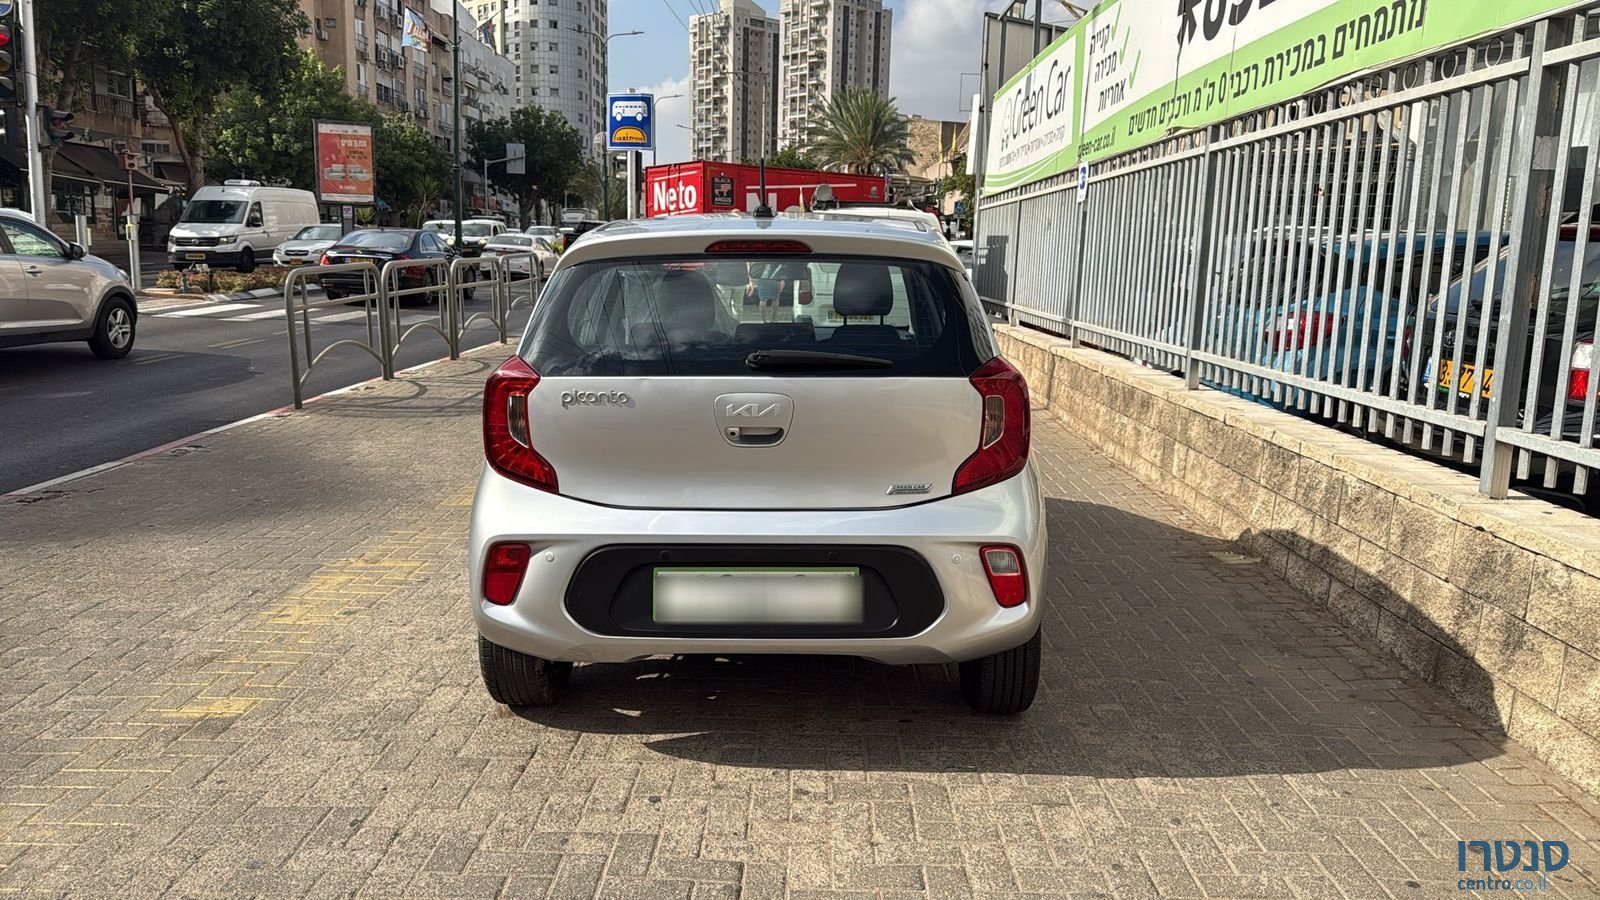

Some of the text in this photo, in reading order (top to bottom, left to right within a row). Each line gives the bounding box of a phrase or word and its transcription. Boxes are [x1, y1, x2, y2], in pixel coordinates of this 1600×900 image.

[1089, 23, 1111, 55] קנייה
[1332, 0, 1425, 60] מתמחים
[1094, 50, 1118, 83] מכירה
[1230, 54, 1259, 99] רכבי
[1262, 33, 1326, 87] במכירת
[1012, 59, 1071, 139] Green Car
[1098, 78, 1127, 112] אחריות
[1218, 71, 1227, 104] 0
[1128, 105, 1157, 136] חדשים
[653, 180, 697, 211] Neto
[560, 388, 629, 409] picanto
[726, 403, 782, 417] KIA
